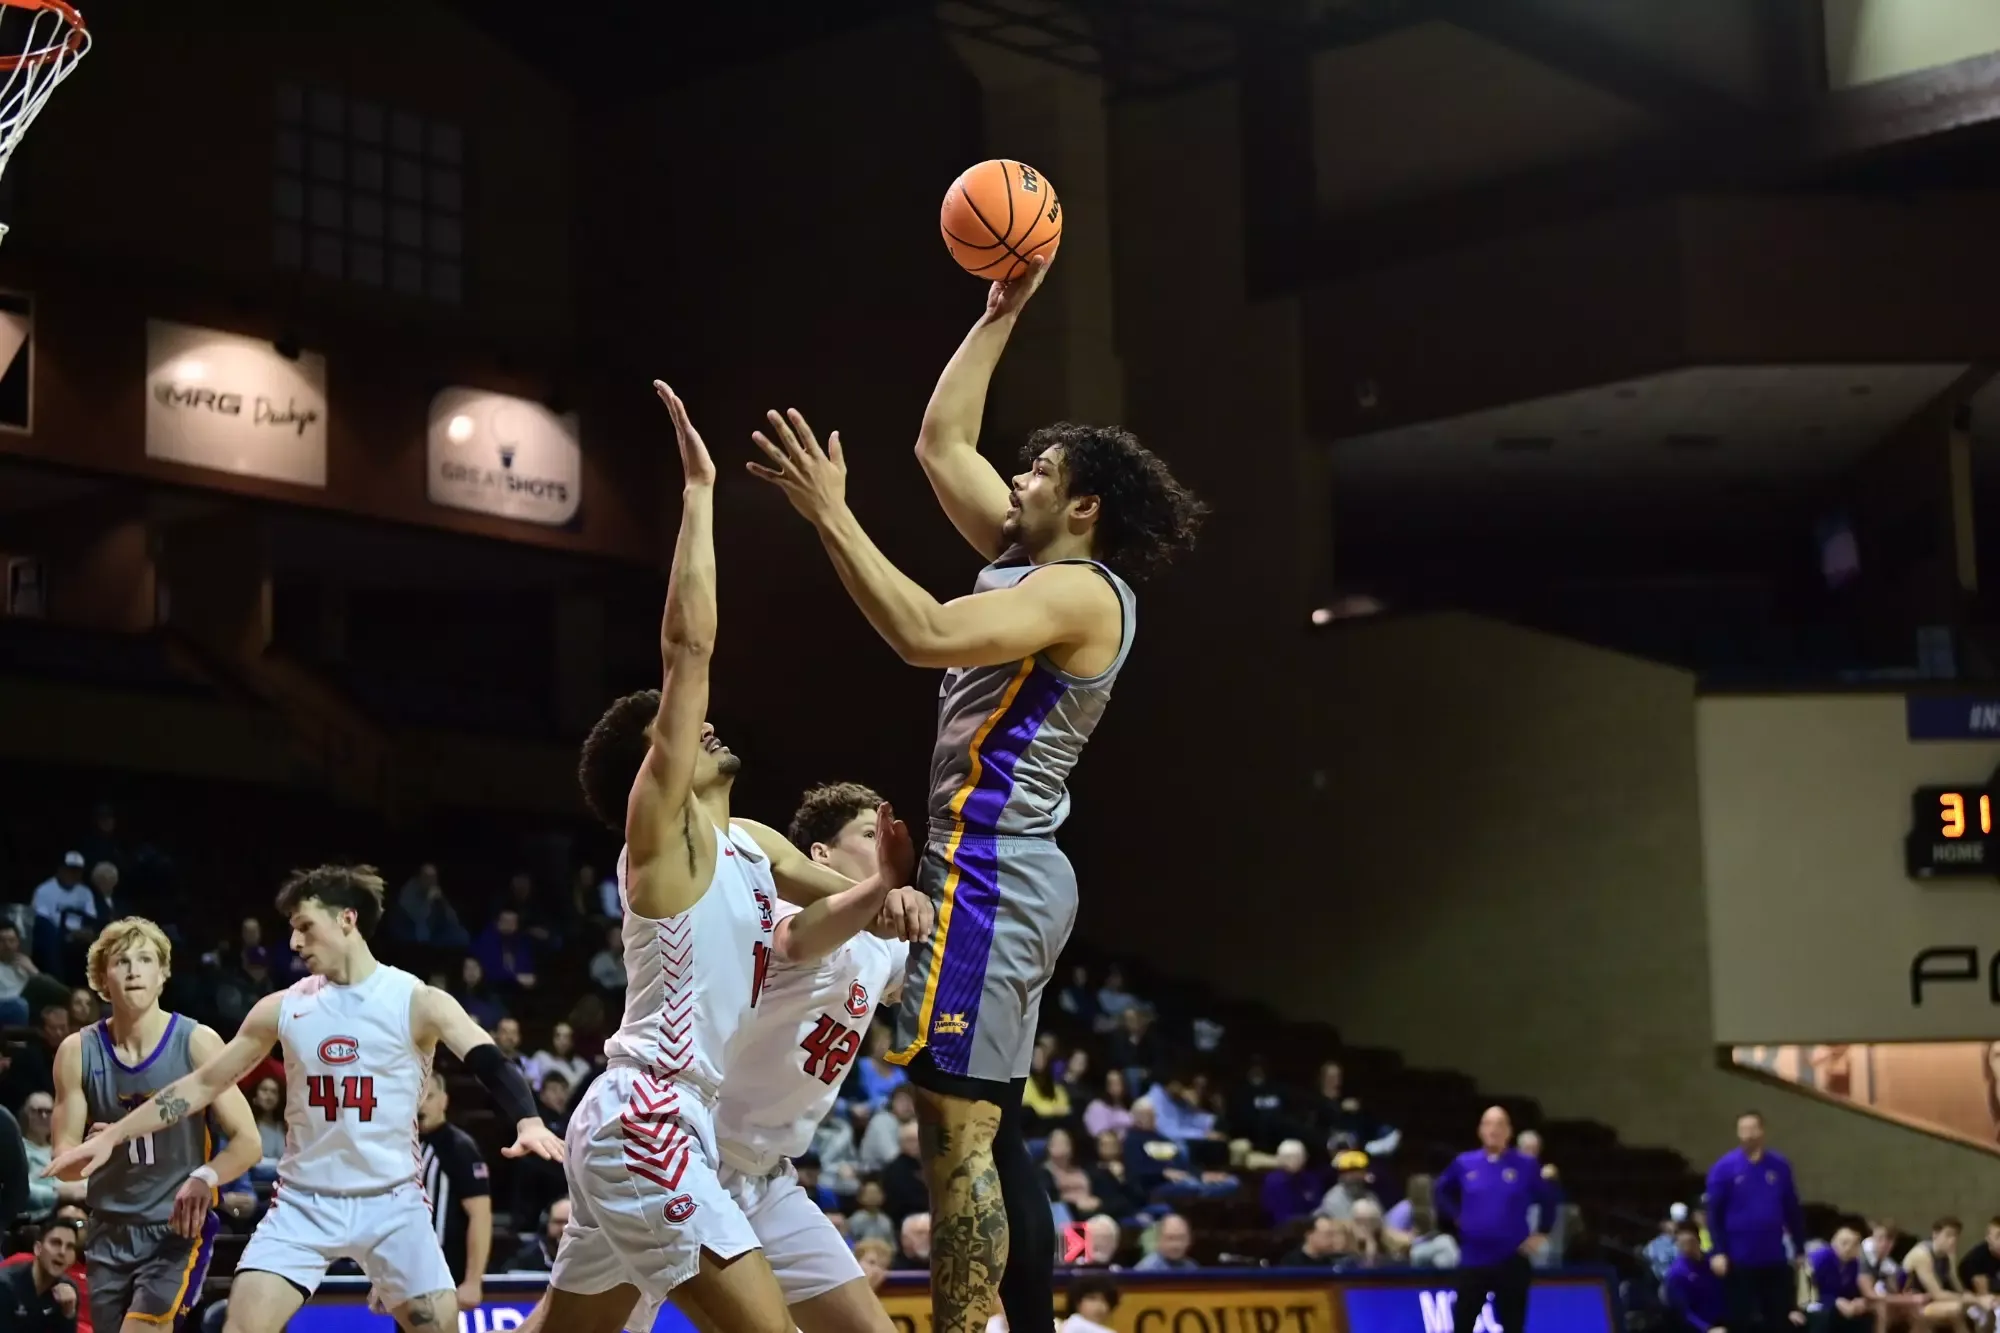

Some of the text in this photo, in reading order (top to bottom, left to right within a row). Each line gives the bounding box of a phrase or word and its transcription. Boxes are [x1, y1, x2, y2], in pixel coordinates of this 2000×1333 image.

[164, 384, 242, 416] MRG
[1939, 792, 1992, 838] 31
[1932, 843, 1985, 863] HOME
[1909, 945, 2000, 1008] P
[800, 1013, 861, 1085] 42
[306, 1075, 378, 1122] 44
[1133, 1305, 1320, 1333] COURT
